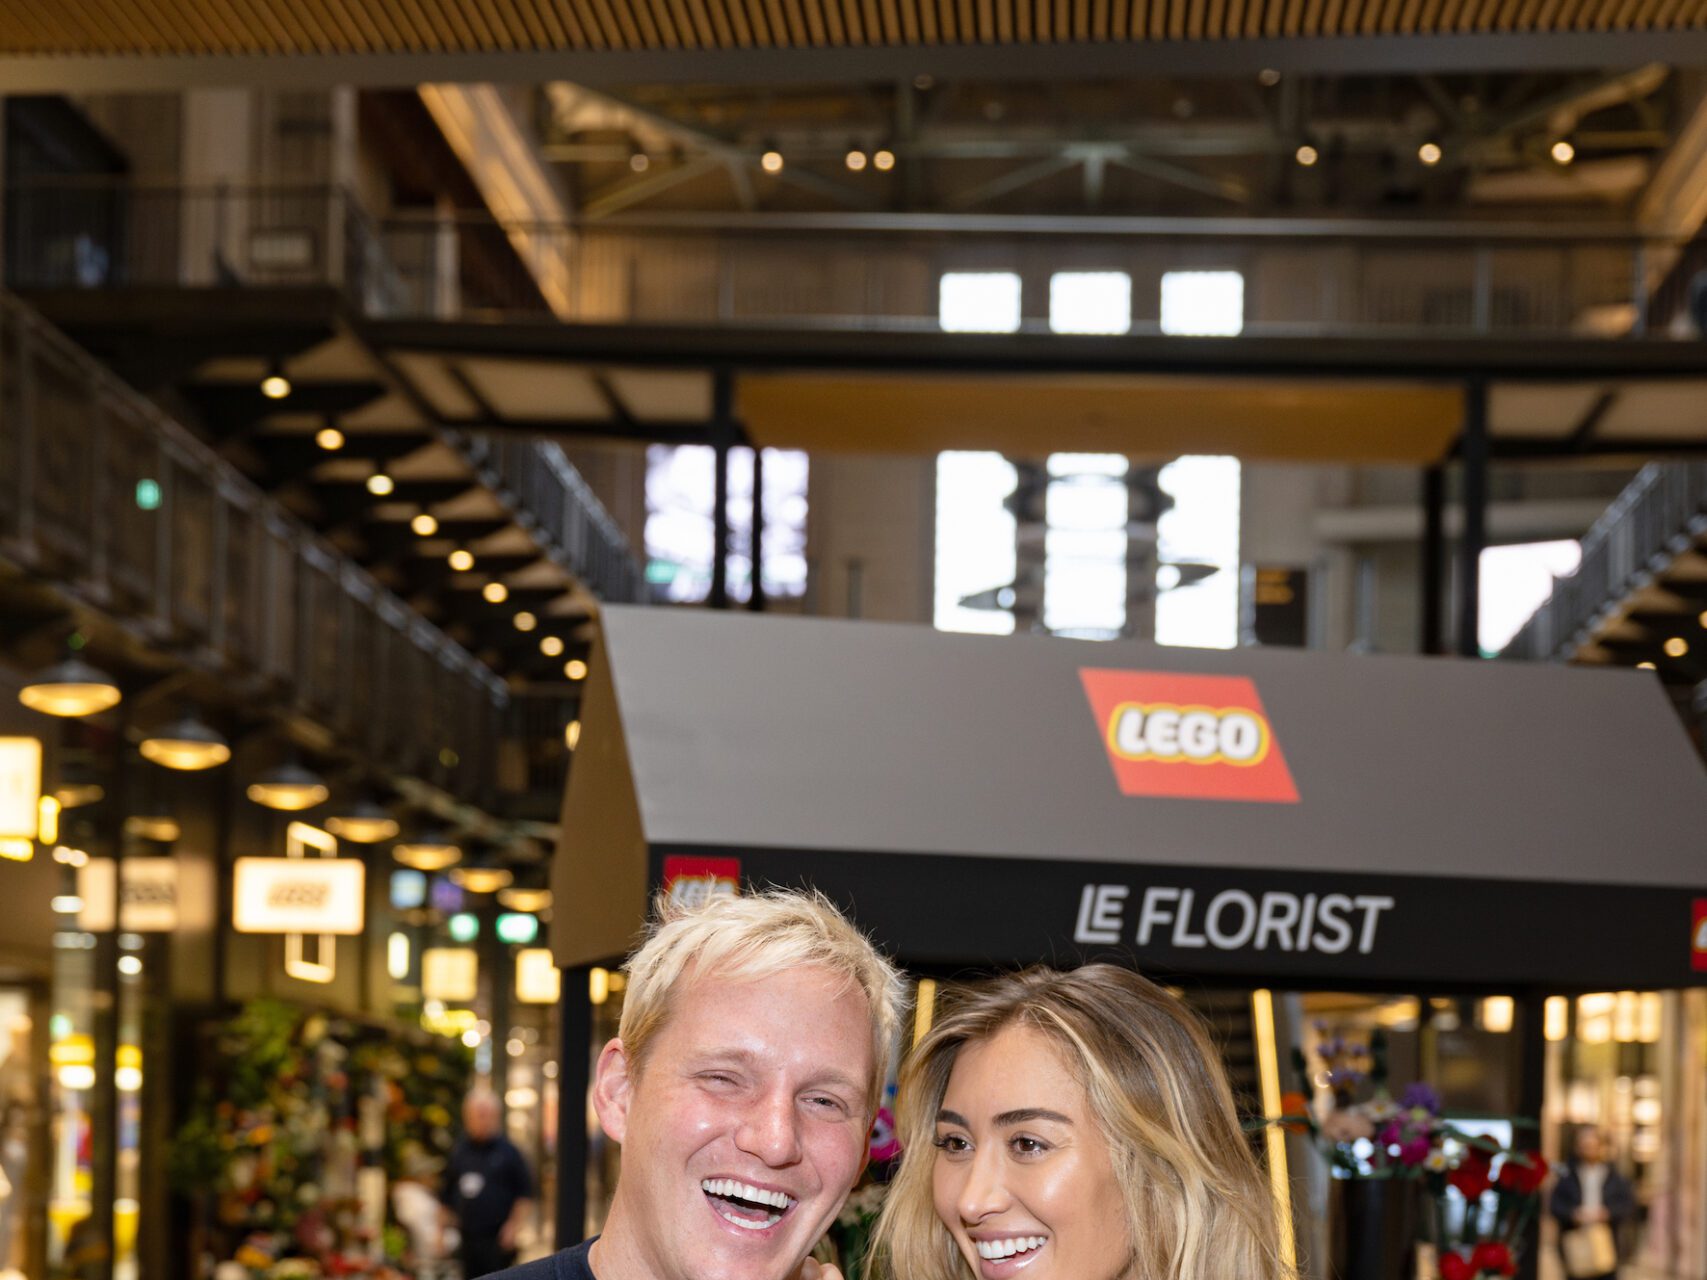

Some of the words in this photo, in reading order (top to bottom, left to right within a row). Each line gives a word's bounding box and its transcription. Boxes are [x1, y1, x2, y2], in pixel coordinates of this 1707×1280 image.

[1116, 708, 1261, 761] LEGO
[1074, 884, 1129, 944] LE
[1136, 887, 1394, 954] FLORIST
